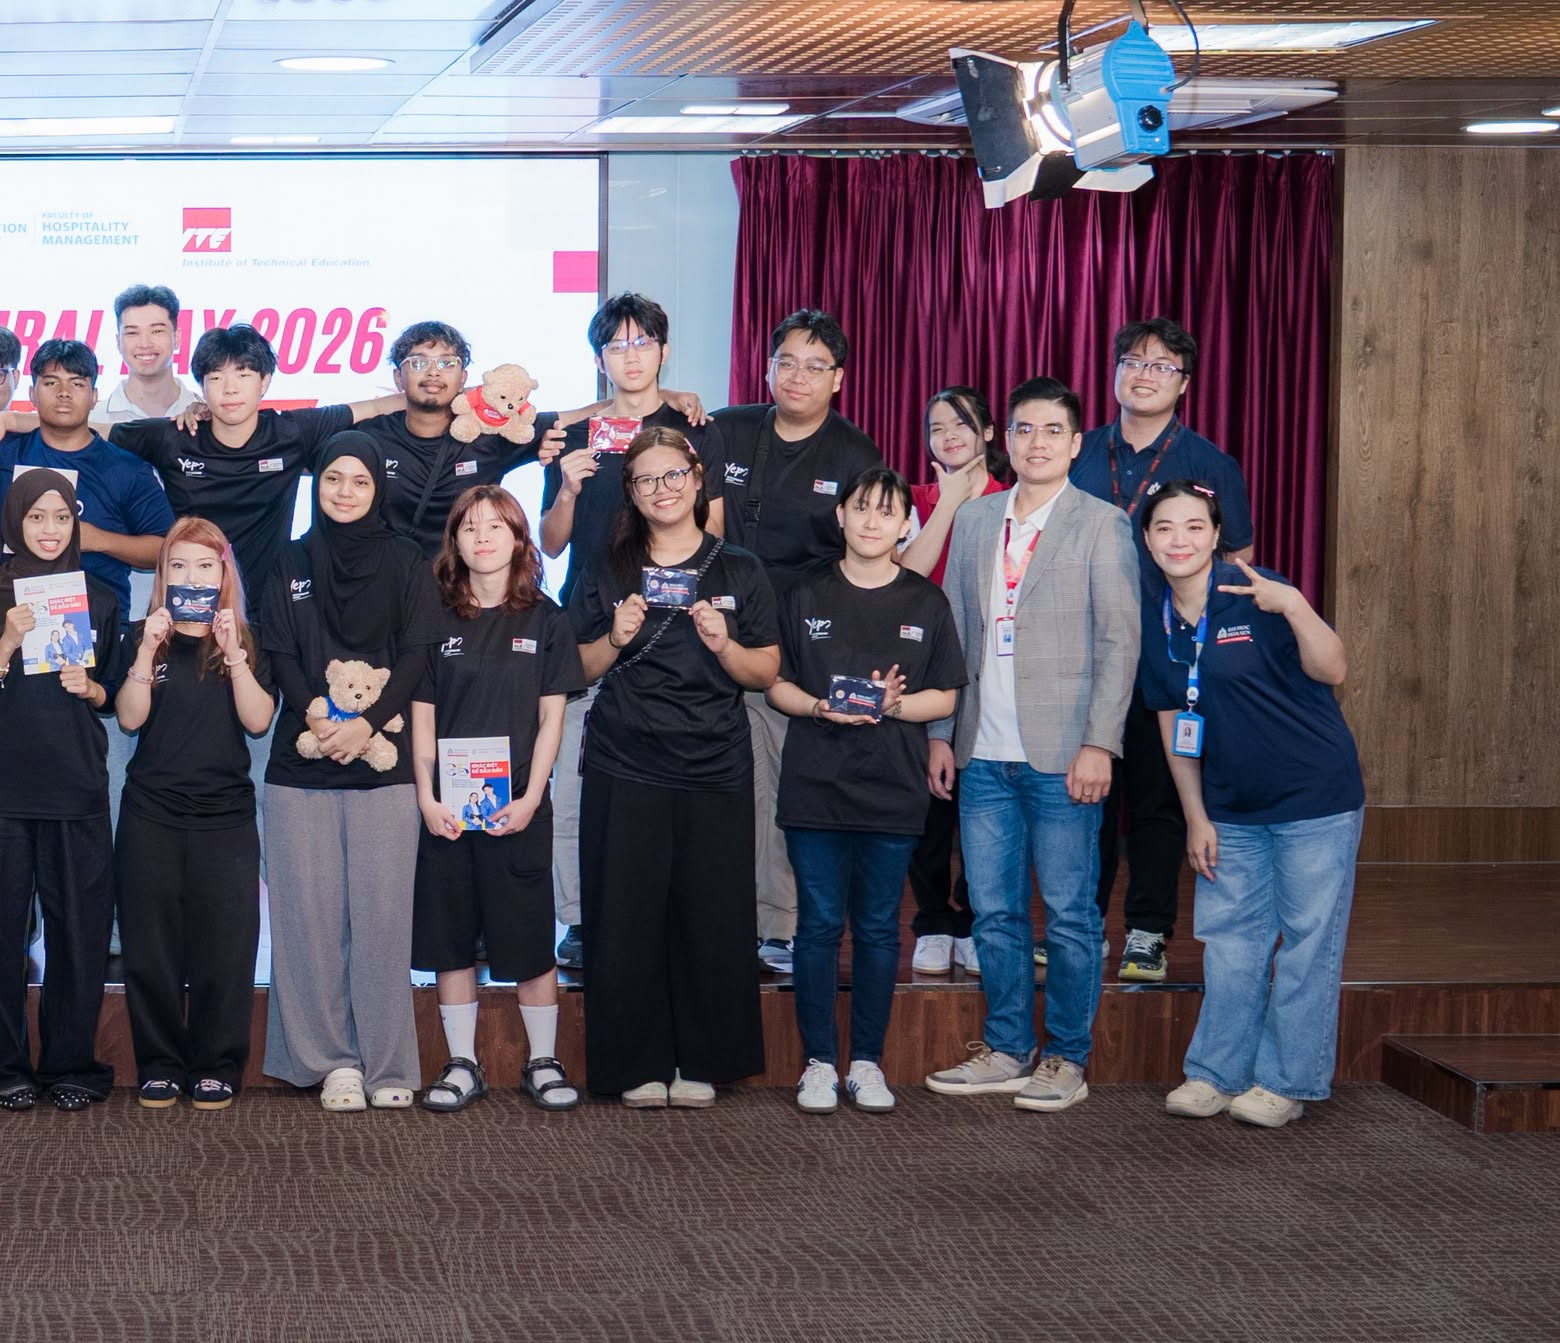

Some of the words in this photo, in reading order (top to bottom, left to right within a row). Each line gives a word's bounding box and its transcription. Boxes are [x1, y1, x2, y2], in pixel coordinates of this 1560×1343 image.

[42, 212, 80, 220] FACULTY
[42, 221, 129, 232] HOSPITALITY
[42, 234, 140, 246] MANAGEMENT
[182, 257, 232, 268] Institute
[235, 257, 248, 268] of
[252, 257, 307, 268] Technical
[311, 257, 370, 268] Education
[252, 306, 388, 375] 2026
